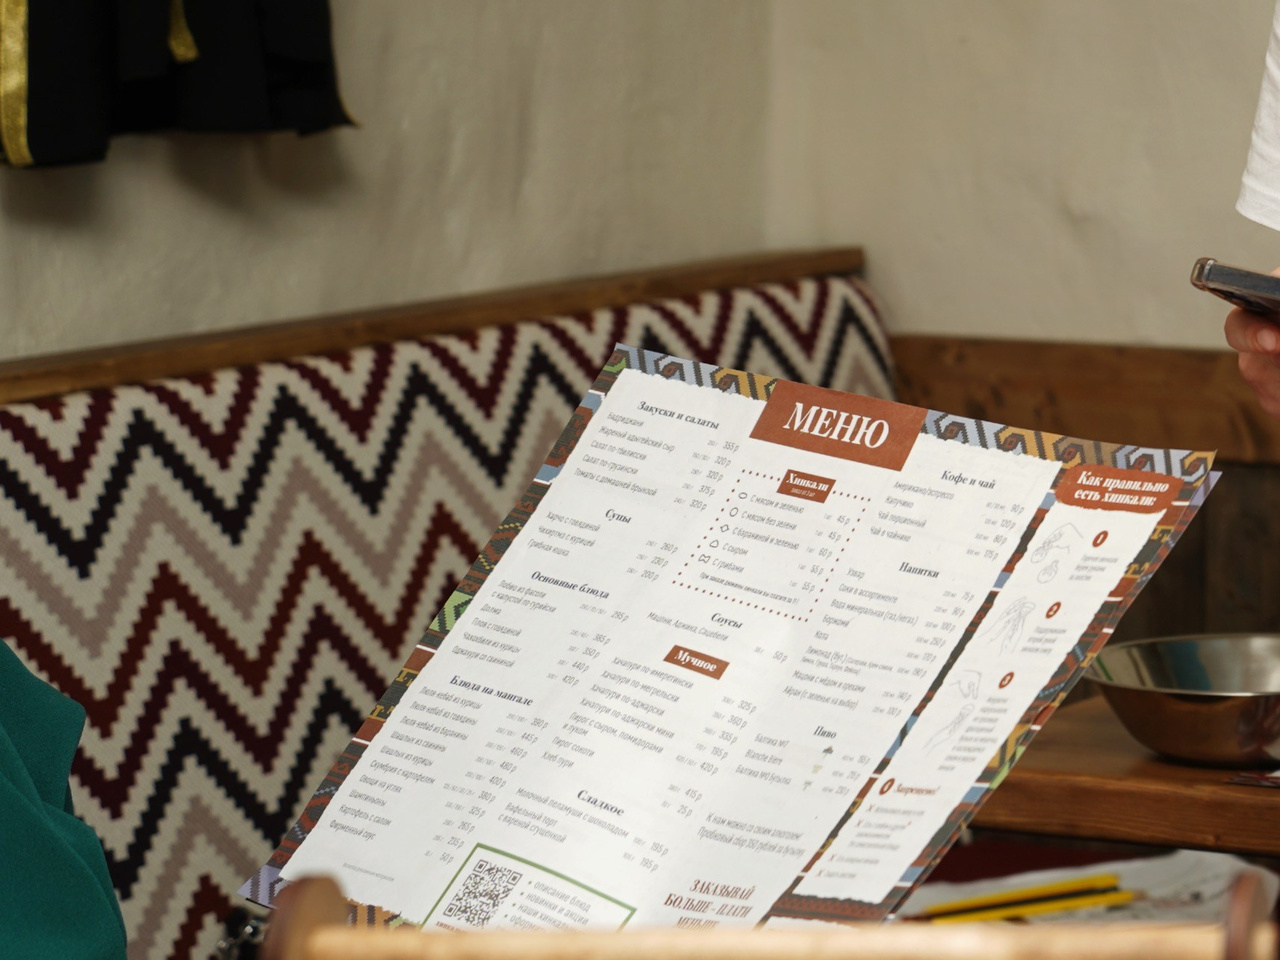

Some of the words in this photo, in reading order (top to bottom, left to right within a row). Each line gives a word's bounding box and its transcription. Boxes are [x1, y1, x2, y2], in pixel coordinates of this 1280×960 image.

[607, 412, 644, 426] Бадриджани
[638, 401, 675, 417] Закуски
[685, 416, 719, 429] салаты
[783, 402, 889, 448] МЕНЮ
[591, 440, 608, 450] Салат
[599, 426, 627, 438] Жареный
[627, 435, 662, 447] адыгейский
[662, 443, 675, 453] сыр
[583, 454, 600, 464] Салат
[600, 460, 638, 474] по-грузински
[575, 468, 595, 479] Томаты
[599, 477, 631, 489] домашней
[631, 484, 657, 496] брынзой
[787, 473, 828, 491] Хинкали
[941, 471, 968, 484] Кофе
[978, 480, 995, 489] чай
[1077, 471, 1103, 486] Как
[1103, 479, 1169, 498] правильно
[755, 498, 774, 506] мясом
[779, 503, 804, 513] зеленью
[885, 496, 913, 508] Капучино
[1074, 490, 1100, 500] есть
[1102, 489, 1156, 505] хинкали:
[546, 512, 564, 522] Харчо
[569, 519, 600, 531] говядиной
[605, 509, 631, 523] Супы
[746, 514, 766, 522] мясом
[765, 517, 776, 525] без
[776, 521, 797, 530] зелени
[878, 511, 889, 519] Чай
[889, 515, 926, 527] порционный
[539, 526, 565, 539] Чихиртма
[570, 536, 595, 547] курицей
[737, 529, 770, 542] бараниной
[774, 539, 799, 550] зеленью
[871, 527, 881, 535] Чай
[887, 531, 911, 542] чайнике
[528, 539, 552, 551] Грибная
[552, 548, 569, 556] юшка
[727, 546, 748, 555] сыром
[717, 561, 744, 572] грибами
[847, 568, 865, 580] Узвар
[899, 562, 939, 578] Напитки
[499, 580, 518, 591] Лобио
[524, 587, 546, 598] фасоли
[532, 572, 578, 589] Основные
[579, 584, 609, 598] блюда
[839, 584, 854, 593] Соки
[858, 590, 898, 603] ассортименте
[496, 593, 523, 604] капустой
[481, 604, 501, 615] Долма
[472, 617, 487, 628] Плов
[491, 624, 521, 636] говядиной
[711, 613, 742, 628] Соусы
[823, 615, 849, 627] Боржоми
[698, 628, 728, 641] Сацебели
[815, 631, 829, 640] Кола
[499, 644, 520, 653] курицы
[675, 650, 716, 671] Мучное
[450, 676, 481, 691] Блюда
[482, 687, 494, 695] на
[497, 691, 533, 705] мангале
[601, 671, 630, 684] Хачапури
[630, 680, 679, 702] по-мегрельски
[612, 657, 641, 670] Хачапури
[641, 666, 693, 688] по-имеретински
[738, 700, 752, 711] 325
[460, 699, 482, 709] курицы
[591, 684, 621, 699] Хачапури
[621, 695, 665, 716] по-аджарски
[719, 731, 733, 741] 335
[450, 713, 477, 725] говядины
[580, 698, 611, 713] Хачапури
[611, 710, 655, 731] по-аджарски
[655, 727, 674, 738] мини
[711, 746, 724, 757] 195
[440, 727, 468, 740] баранины
[567, 725, 588, 736] луком
[814, 726, 836, 738] Пиво
[391, 731, 415, 743] Шашлык
[422, 741, 446, 752] свинины
[552, 736, 572, 748] Пирог
[569, 712, 589, 723] Пирог
[594, 722, 617, 736] сыром,
[619, 732, 663, 753] помидорами
[700, 762, 713, 772] 420
[380, 746, 405, 757] Шашлык
[412, 756, 433, 766] курицы
[370, 760, 398, 773] Скумбрия
[401, 771, 435, 784] картофелем
[360, 775, 379, 786] Овощи
[384, 784, 402, 793] углях
[541, 752, 558, 761] Хлеб
[557, 757, 574, 767] пури
[677, 805, 688, 814] 25
[349, 790, 385, 806] Шампиньоны
[578, 790, 624, 815] Сладкое
[339, 805, 369, 819] Картофель
[373, 816, 391, 825] салом
[505, 803, 542, 820] Вафельный
[542, 816, 557, 827] торт
[516, 788, 549, 804] Молочный
[548, 800, 583, 817] пеламуши
[588, 816, 628, 837] шоколадом
[330, 820, 363, 835] Фирменный
[362, 831, 376, 841] соус
[503, 815, 530, 829] вареной
[529, 825, 566, 842] сгущенкой
[534, 882, 570, 901] описание
[570, 896, 591, 913] блюд
[690, 880, 754, 899] ЗАКАЗЫВАЙ
[526, 894, 558, 910] новинки
[564, 910, 589, 926] акции
[664, 894, 710, 912] БОЛЬШЕ
[716, 904, 752, 917] ПЛАТИ
